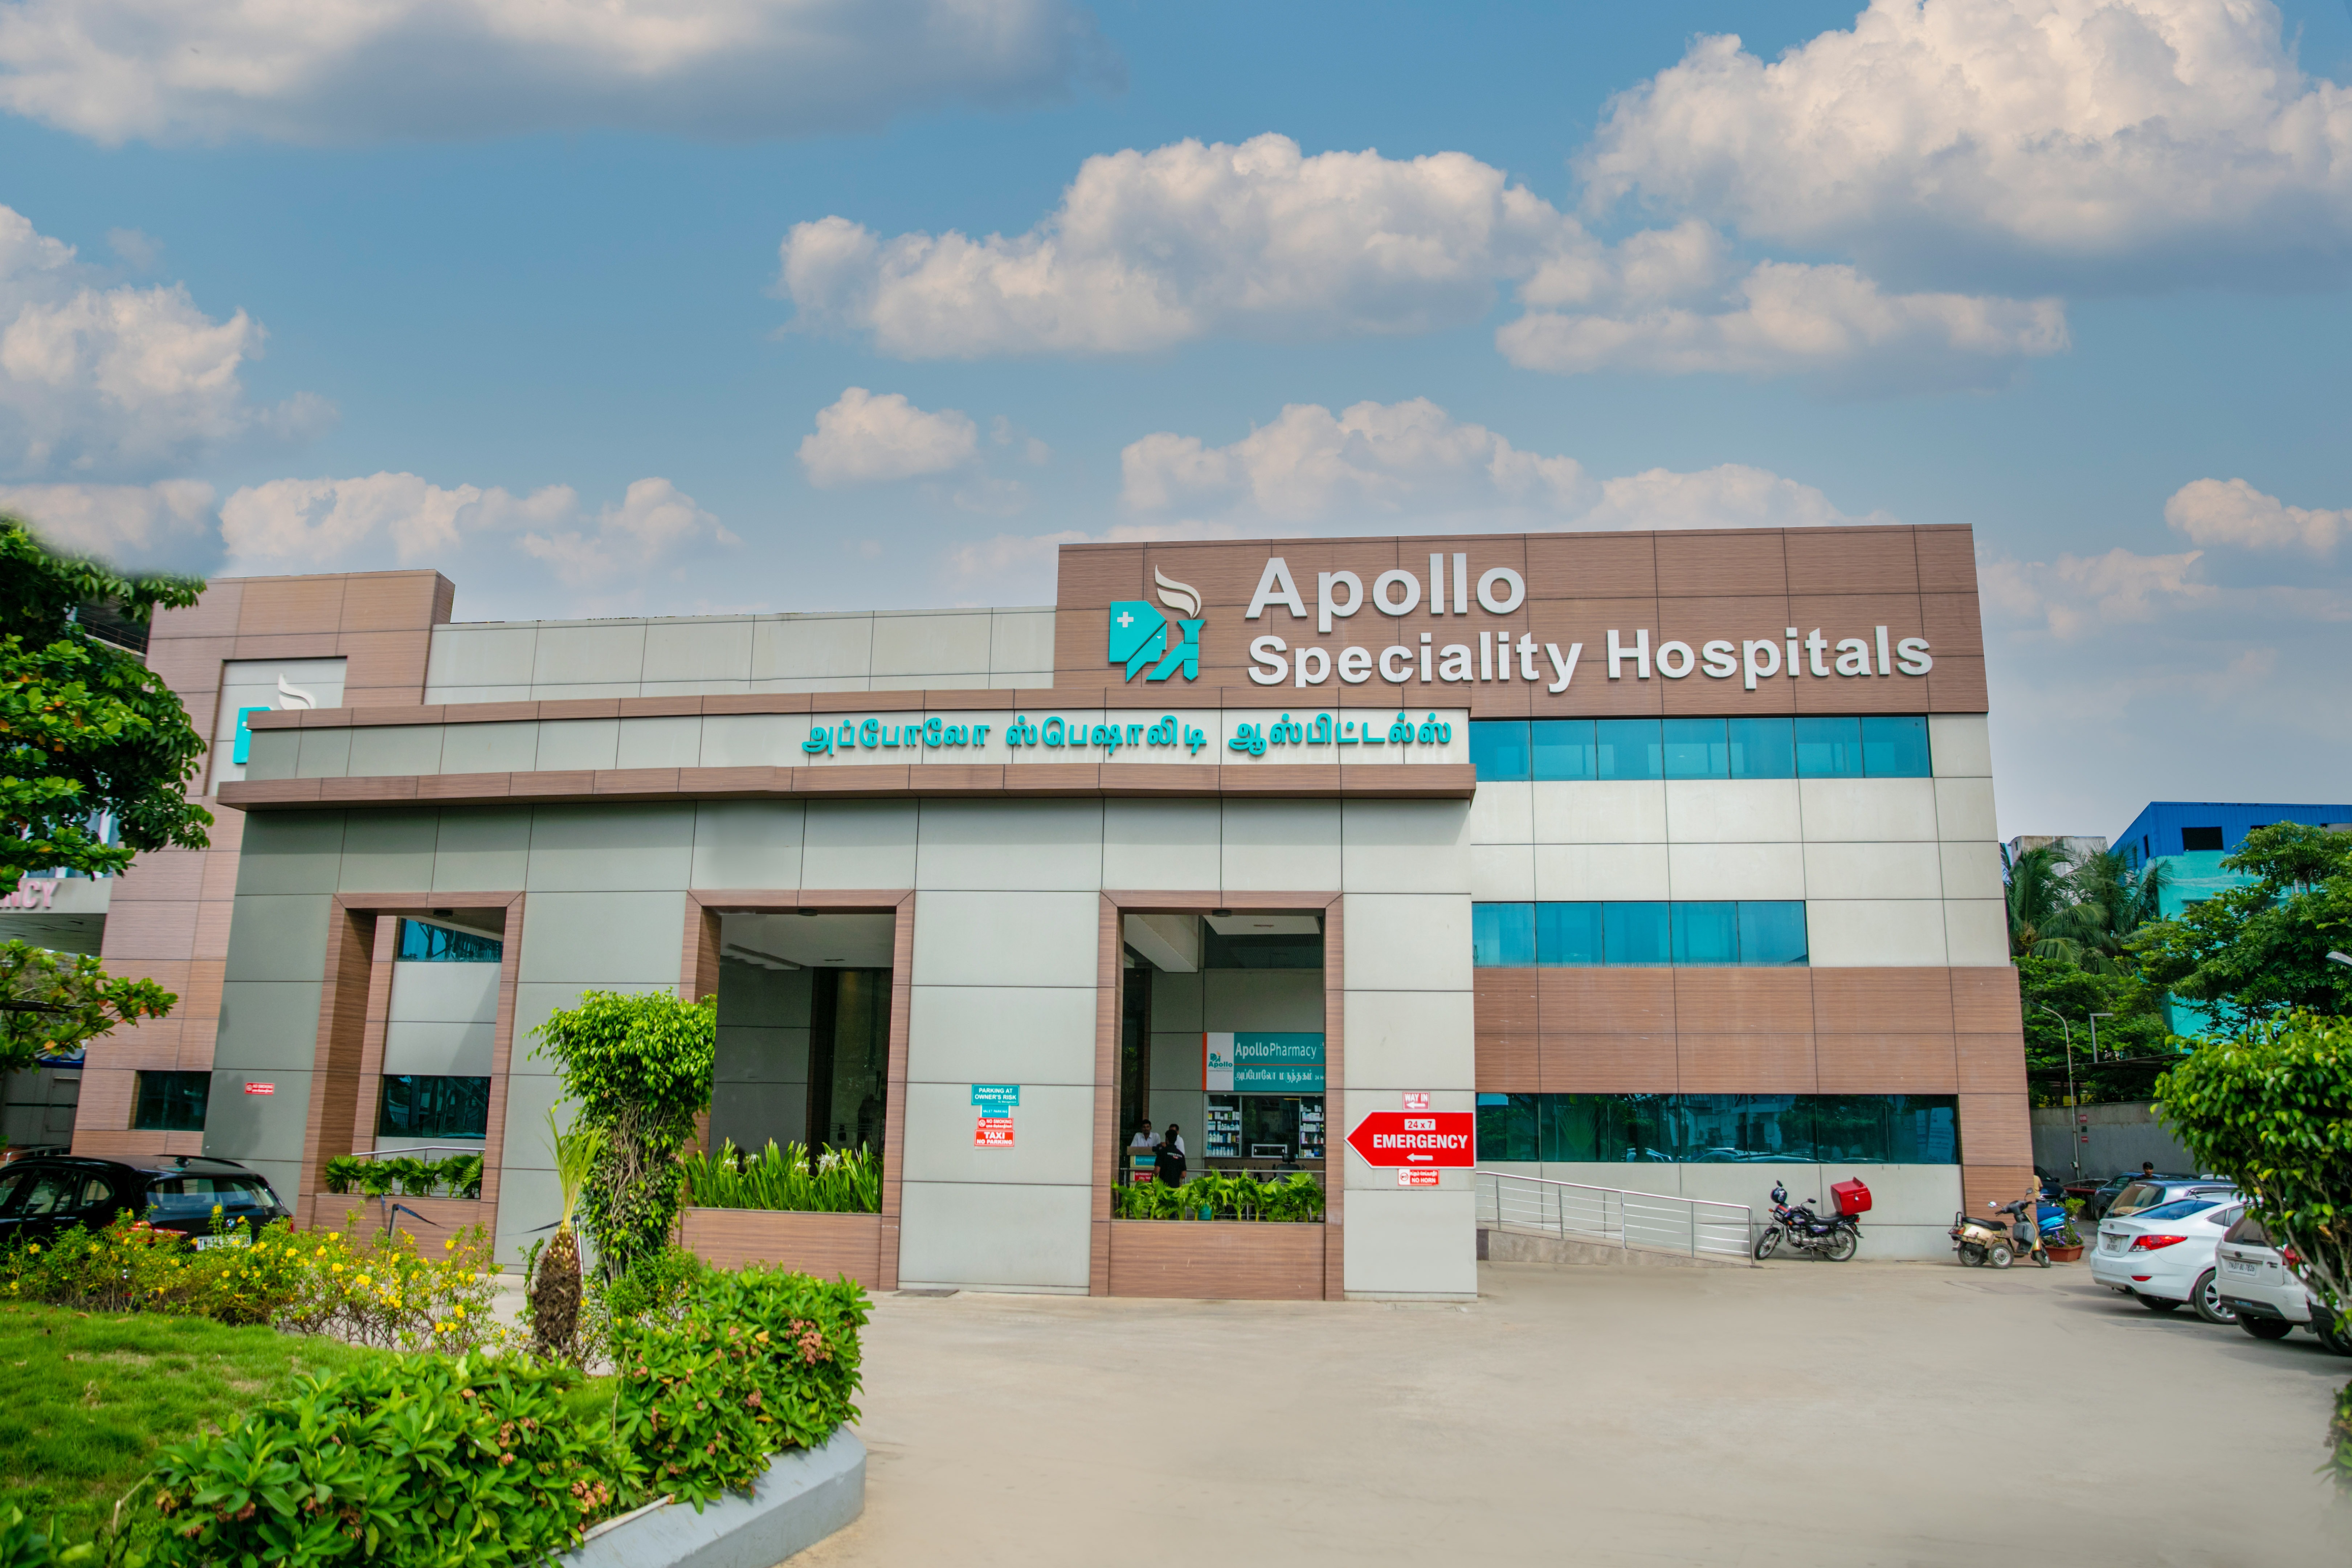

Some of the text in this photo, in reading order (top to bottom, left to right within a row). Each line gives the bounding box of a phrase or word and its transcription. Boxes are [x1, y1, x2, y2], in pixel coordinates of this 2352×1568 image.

[1245, 553, 1525, 633] Apollo
[1248, 625, 1933, 693] Speciality Hospitals
[801, 712, 1451, 755] அப்போலோ ஸ்பெஷாலிடி ஆஸ்பிட்டல்ஸ்
[1235, 1069, 1313, 1083] அப்போலோ மருந்தகம்
[1405, 1093, 1419, 1102] WAY
[1373, 1134, 1468, 1149] EMERGENCY
